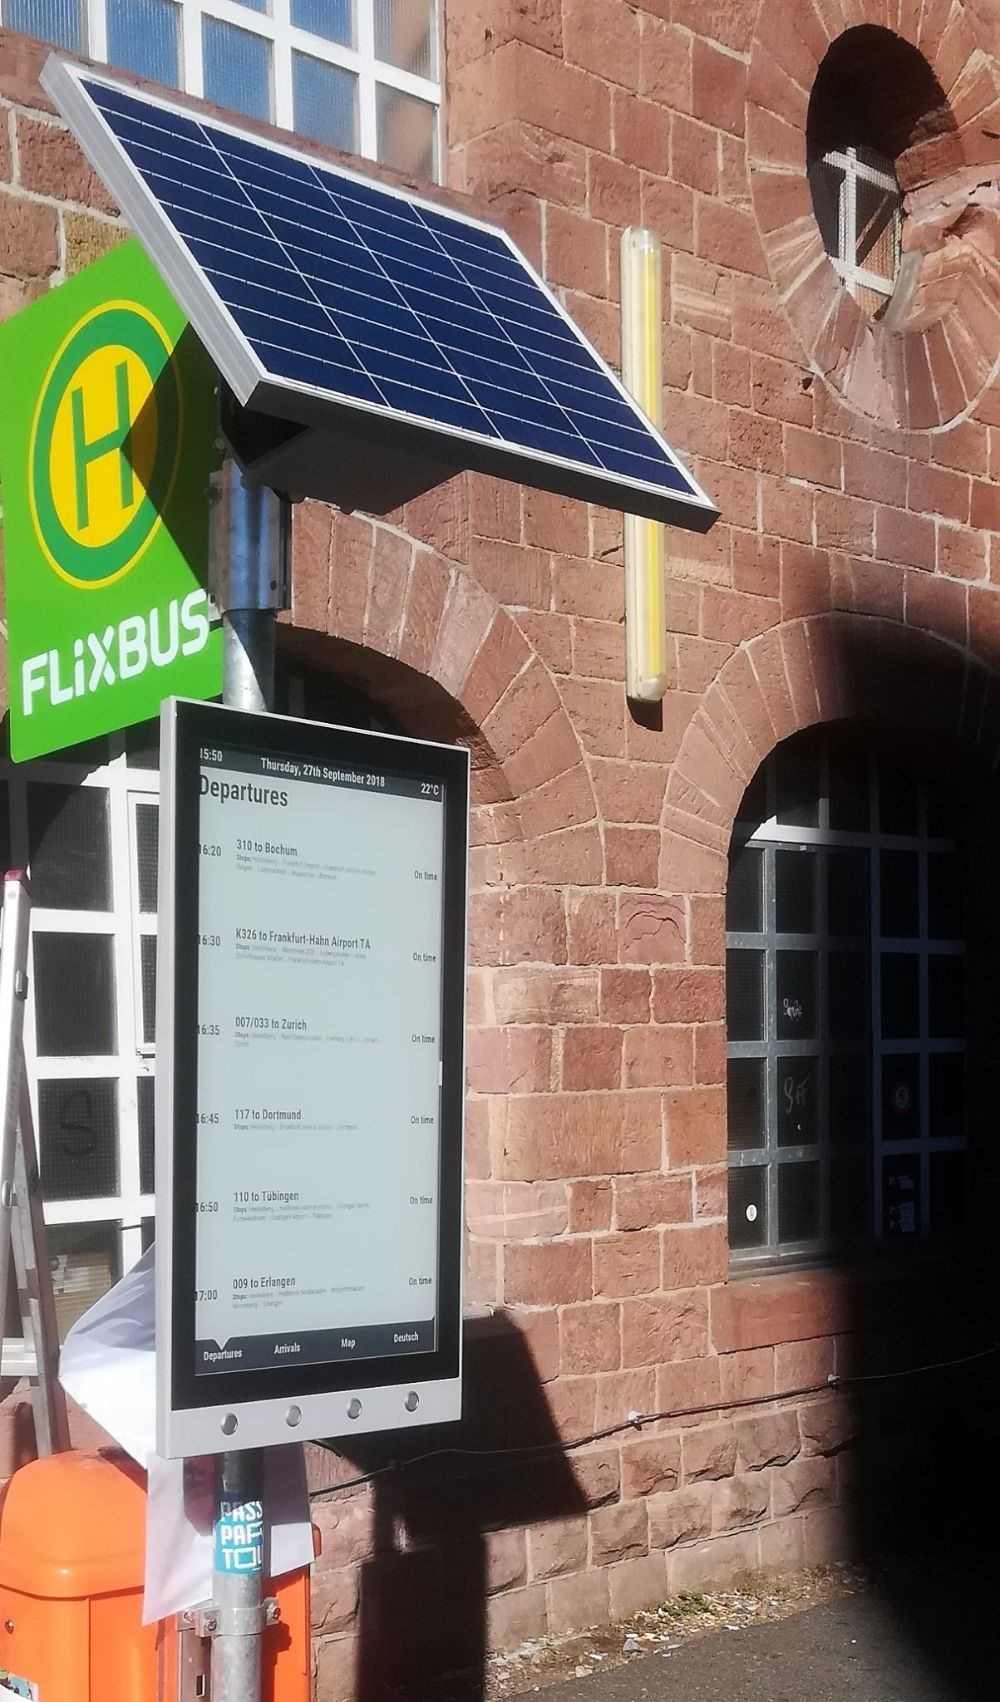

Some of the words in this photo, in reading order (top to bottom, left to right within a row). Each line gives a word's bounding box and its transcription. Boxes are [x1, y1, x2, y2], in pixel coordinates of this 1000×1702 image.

[71, 361, 134, 532] H
[199, 747, 223, 762] 15:50
[260, 757, 302, 777] Thursday,
[303, 766, 321, 778] 27th
[322, 768, 365, 785] September
[366, 774, 385, 787] 2018
[199, 774, 289, 807] Departures
[420, 782, 440, 796] 22°C
[198, 843, 222, 857] 16:20
[236, 839, 253, 852] 310
[254, 841, 263, 853] to
[265, 842, 298, 857] Bochum
[414, 870, 423, 880] On
[424, 871, 438, 881] time
[235, 928, 257, 941] K326
[259, 930, 267, 941] to
[269, 931, 330, 946] Frankfurt-Hahn
[331, 936, 358, 950] Airport
[359, 938, 371, 950] TA
[412, 952, 422, 962] On
[423, 953, 437, 963] time
[235, 1016, 269, 1029] 007/033
[271, 1019, 280, 1030] to
[281, 1019, 307, 1031] Zurich
[411, 1034, 421, 1043] On
[422, 1034, 436, 1044] time
[234, 1109, 250, 1120] 117
[252, 1110, 260, 1120] to
[262, 1109, 302, 1120] Dortmund
[410, 1115, 420, 1124] On
[420, 1115, 434, 1124] time
[233, 1192, 249, 1202] 110
[251, 1192, 260, 1202] to
[410, 1196, 419, 1205] On
[420, 1196, 433, 1205] time
[232, 1278, 248, 1289] 009
[250, 1278, 259, 1288] to
[261, 1276, 296, 1288] Erlangen
[408, 1277, 418, 1286] On
[418, 1276, 432, 1286] time
[341, 1338, 356, 1349] Map
[393, 1332, 419, 1343] Deutsch
[274, 1343, 300, 1354] Arrivals
[203, 1348, 243, 1363] Departures
